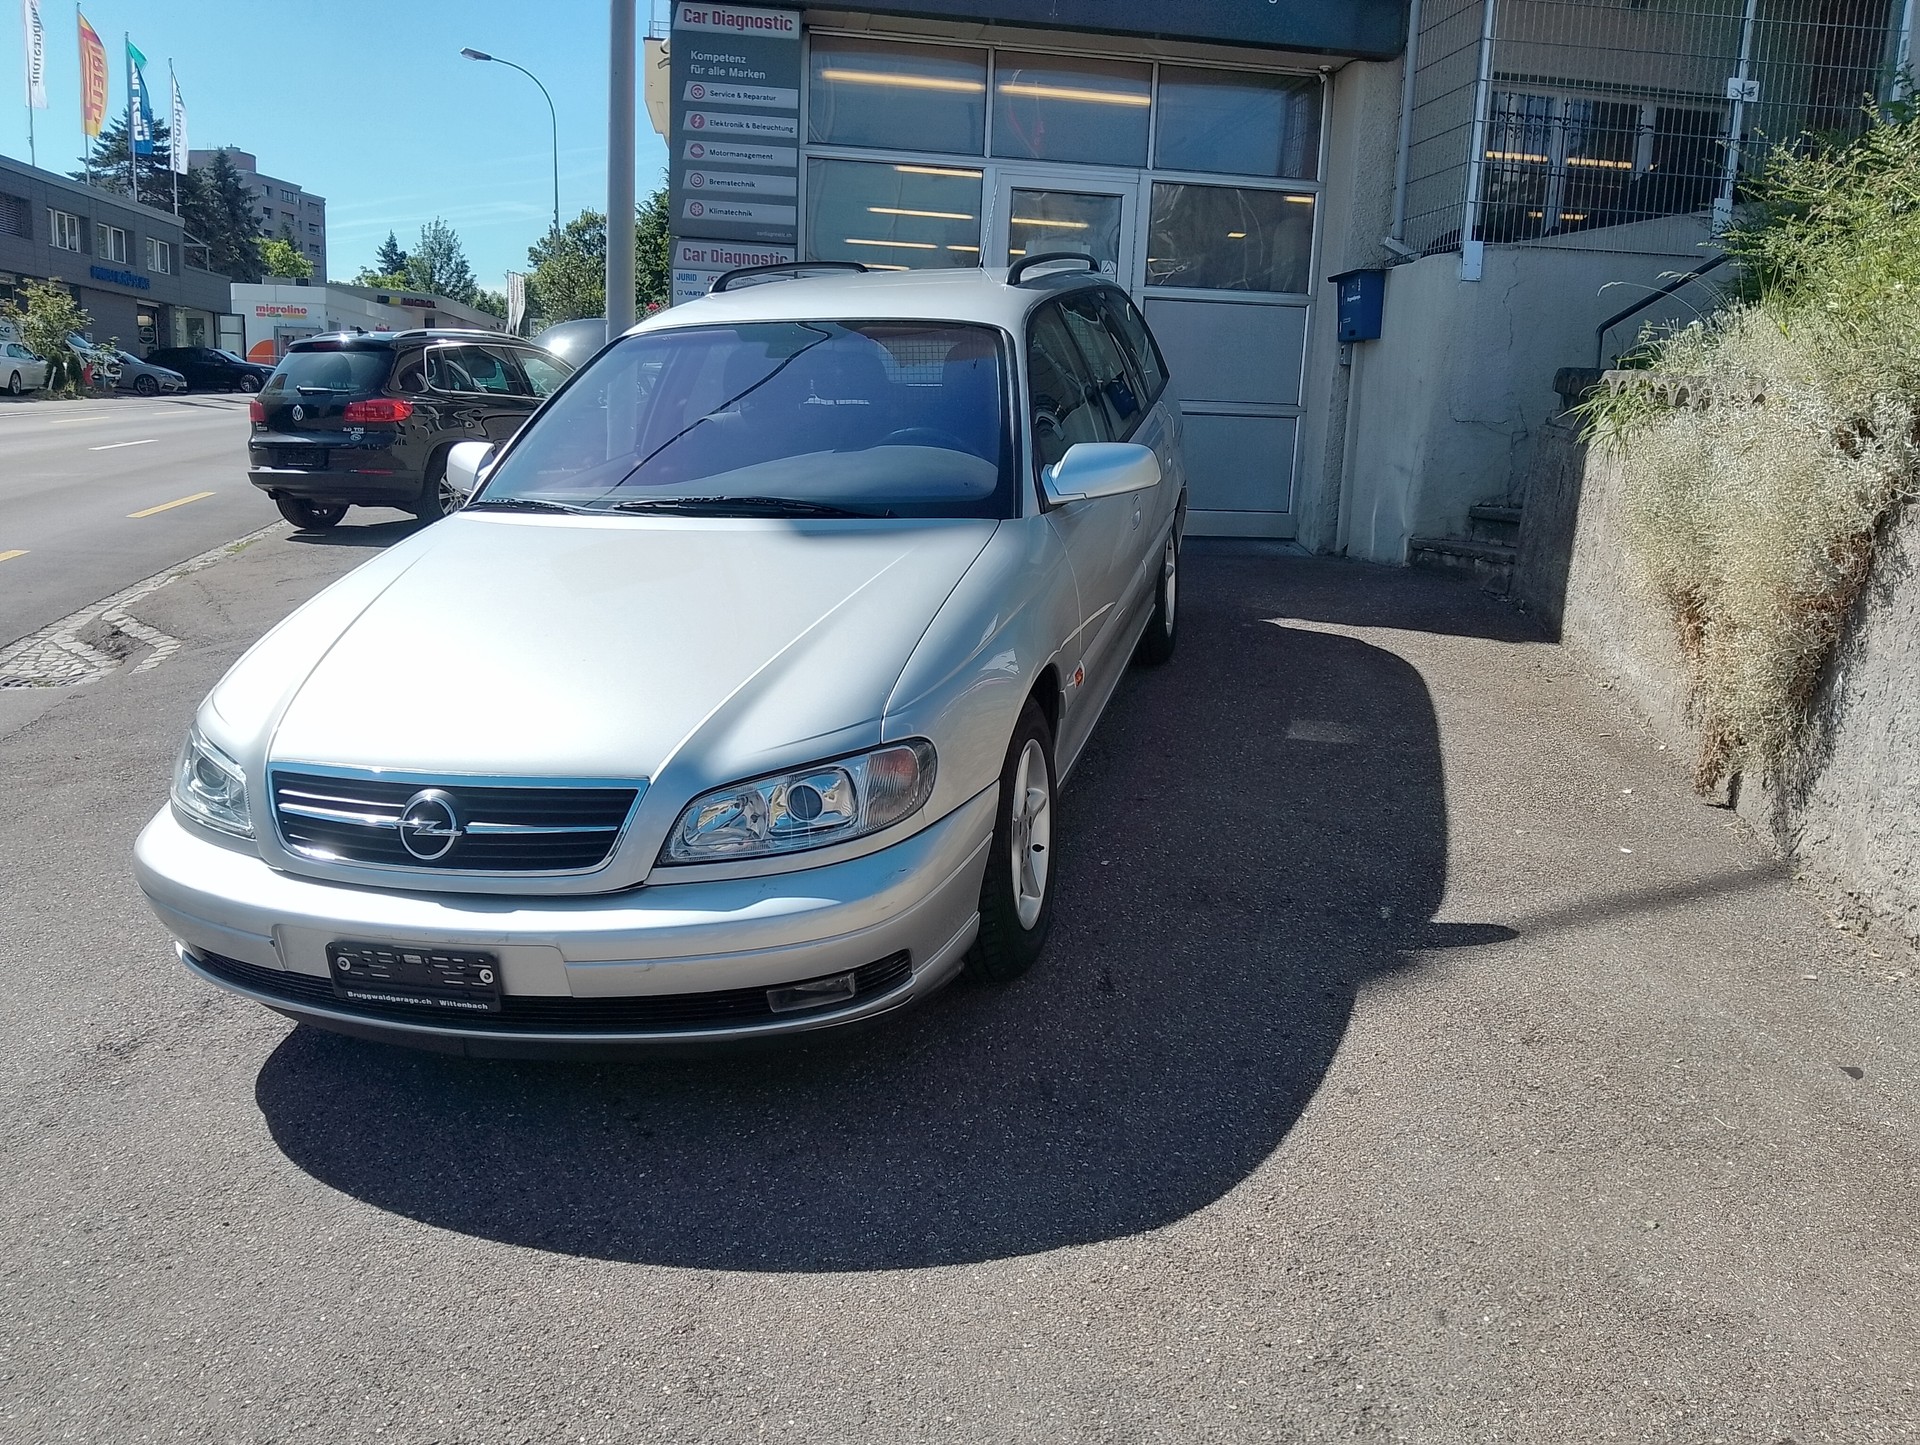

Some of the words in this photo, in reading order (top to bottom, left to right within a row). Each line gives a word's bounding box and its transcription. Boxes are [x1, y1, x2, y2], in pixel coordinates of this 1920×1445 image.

[683, 8, 708, 24] Car
[712, 10, 793, 31] Diagnostic
[690, 50, 747, 64] Kompetenz
[690, 64, 705, 75] für
[708, 65, 726, 76] alle
[729, 67, 766, 79] Marken
[709, 90, 736, 99] Service
[743, 92, 777, 101] Reparatur
[709, 119, 745, 129] Elektronik
[752, 122, 794, 133] Beleuchtung
[709, 149, 773, 160] Motormanagement
[709, 178, 756, 188] Bremstechnik
[709, 207, 753, 217] Klimatechnik
[683, 247, 707, 262] Car
[676, 273, 697, 282] JURID
[255, 303, 307, 315] migrolino
[401, 297, 437, 309] MIGROL
[347, 991, 432, 1005] Bruggwaldgarage.ch
[439, 1000, 488, 1010] Wittenbach
